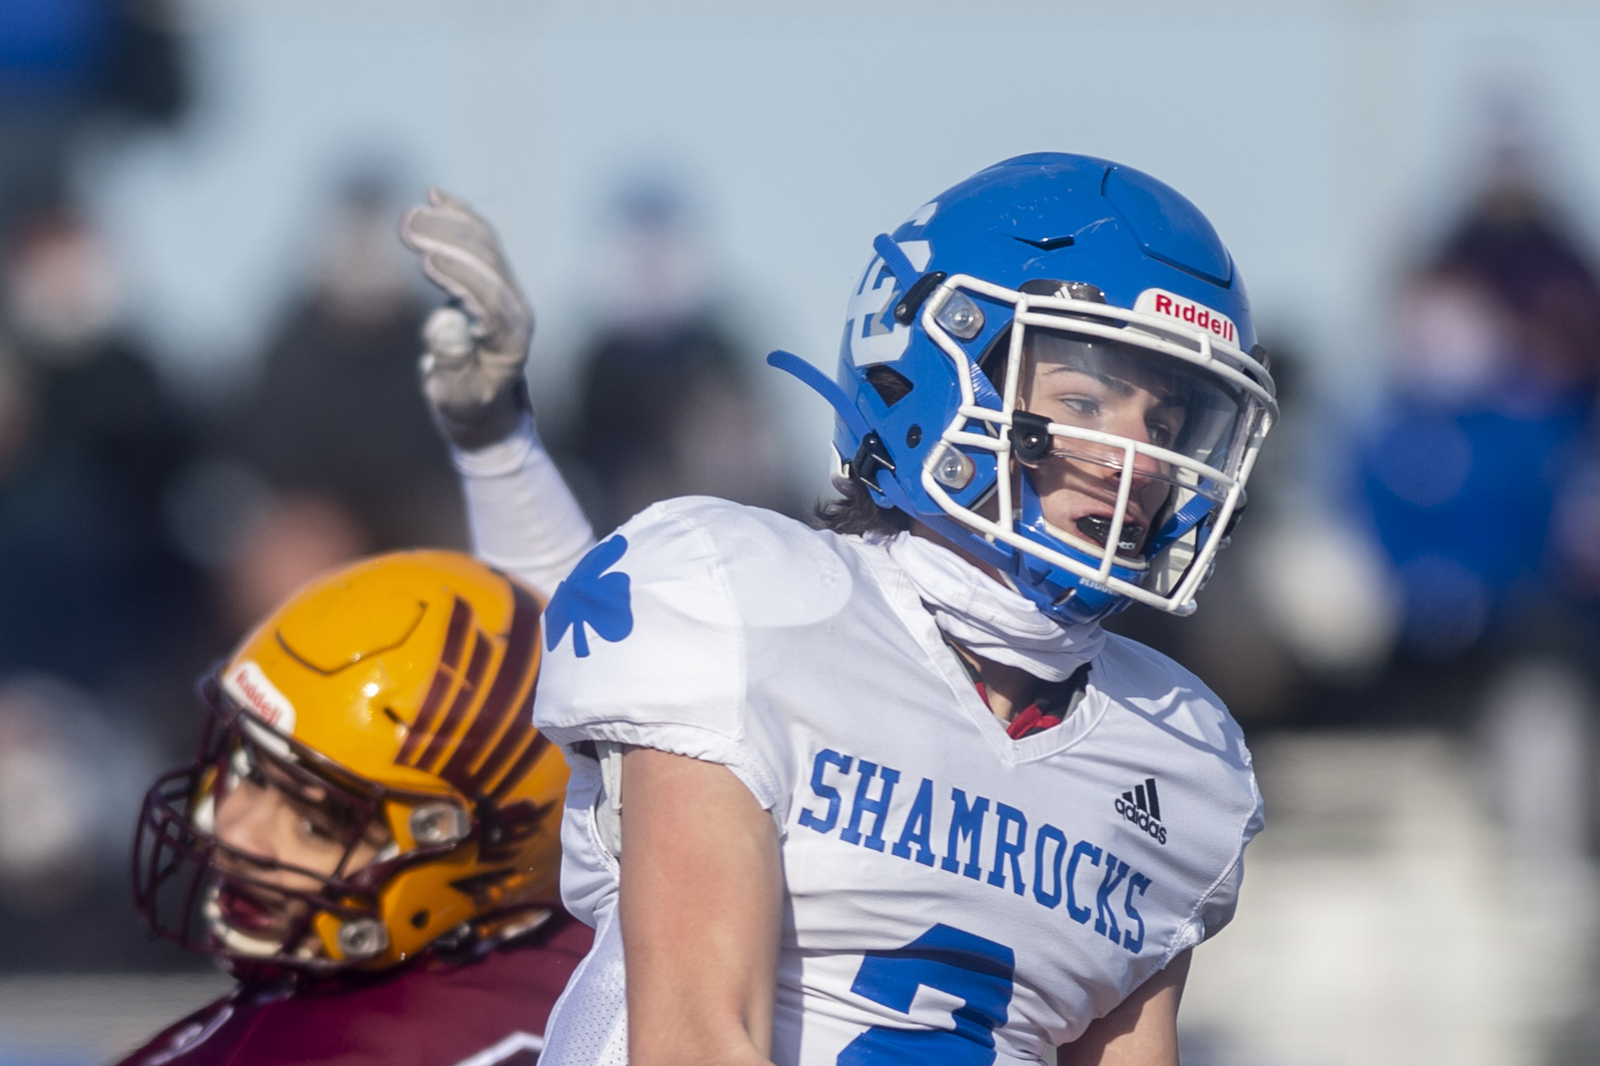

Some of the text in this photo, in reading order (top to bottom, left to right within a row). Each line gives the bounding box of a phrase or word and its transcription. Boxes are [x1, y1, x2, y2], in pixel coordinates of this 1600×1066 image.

[1155, 293, 1234, 342] Riddell
[1114, 798, 1168, 846] adidas
[797, 748, 1152, 955] SHAMROCKS
